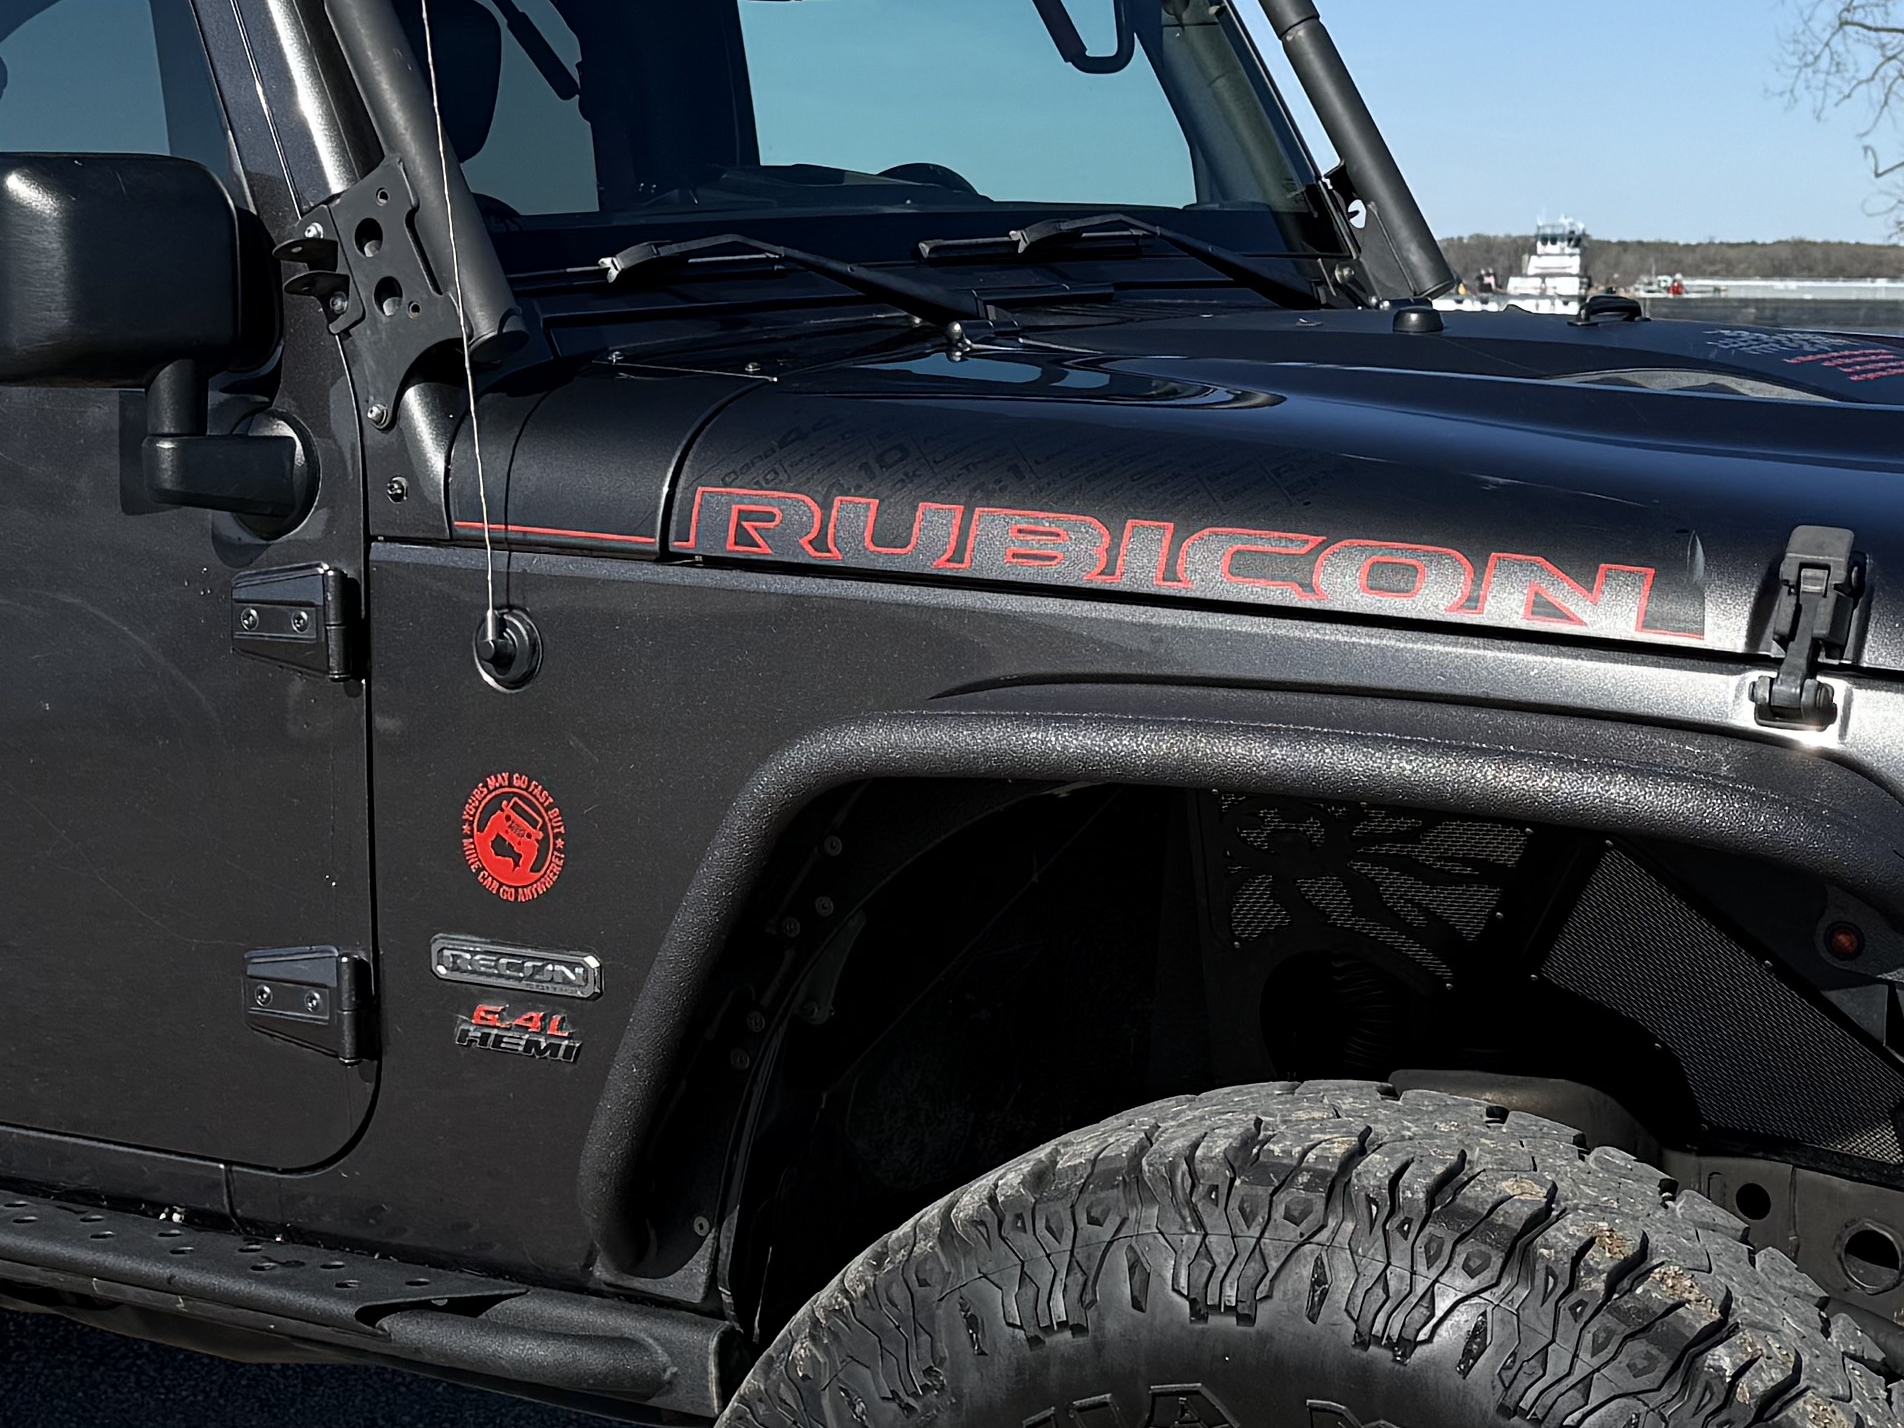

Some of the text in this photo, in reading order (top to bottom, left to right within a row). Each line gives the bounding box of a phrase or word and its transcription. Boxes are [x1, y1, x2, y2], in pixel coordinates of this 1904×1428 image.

[691, 484, 1706, 639] RUBICON
[461, 772, 566, 834] YOURS MAY GO FAST BUT
[462, 838, 482, 873] MINE
[477, 871, 498, 894] CAN
[499, 885, 515, 902] GO
[442, 950, 587, 985] RECON
[454, 1026, 583, 1064] HEMI
